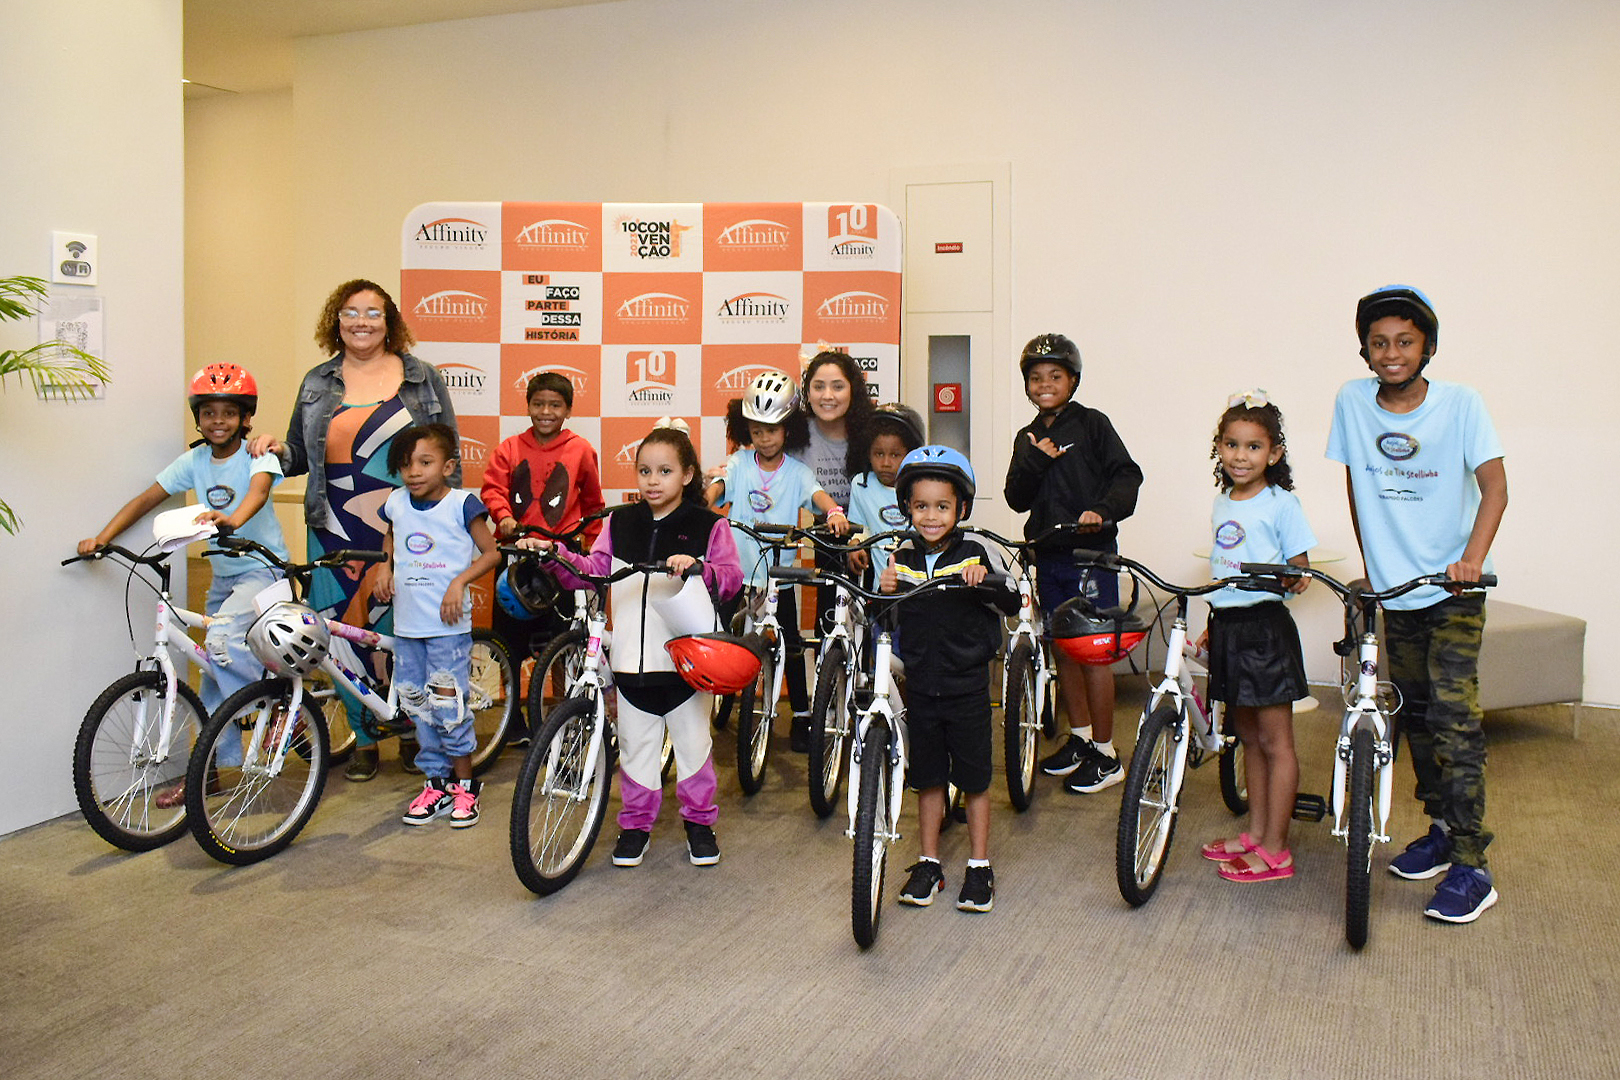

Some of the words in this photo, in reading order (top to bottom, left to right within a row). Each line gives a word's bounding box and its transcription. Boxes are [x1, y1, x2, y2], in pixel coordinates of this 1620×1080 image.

[637, 221, 670, 233] CON
[837, 204, 867, 236] 10
[415, 223, 488, 246] Affinity
[516, 224, 589, 247] Affinity
[637, 233, 670, 245] VEN
[718, 225, 790, 247] Affinity
[831, 243, 876, 257] Affinity
[527, 274, 544, 284] EU
[546, 287, 579, 299] FAÇO
[415, 295, 488, 319] Affinity
[527, 300, 567, 310] PARTE
[617, 299, 690, 321] Affinity
[718, 298, 790, 320] Affinity
[817, 297, 889, 320] Affinity
[541, 314, 581, 325] DESSA
[526, 330, 577, 340] HISTÓRIA
[634, 350, 666, 382] 10
[854, 358, 877, 370] AÇO
[439, 368, 487, 392] inity
[628, 389, 673, 404] Affinity
